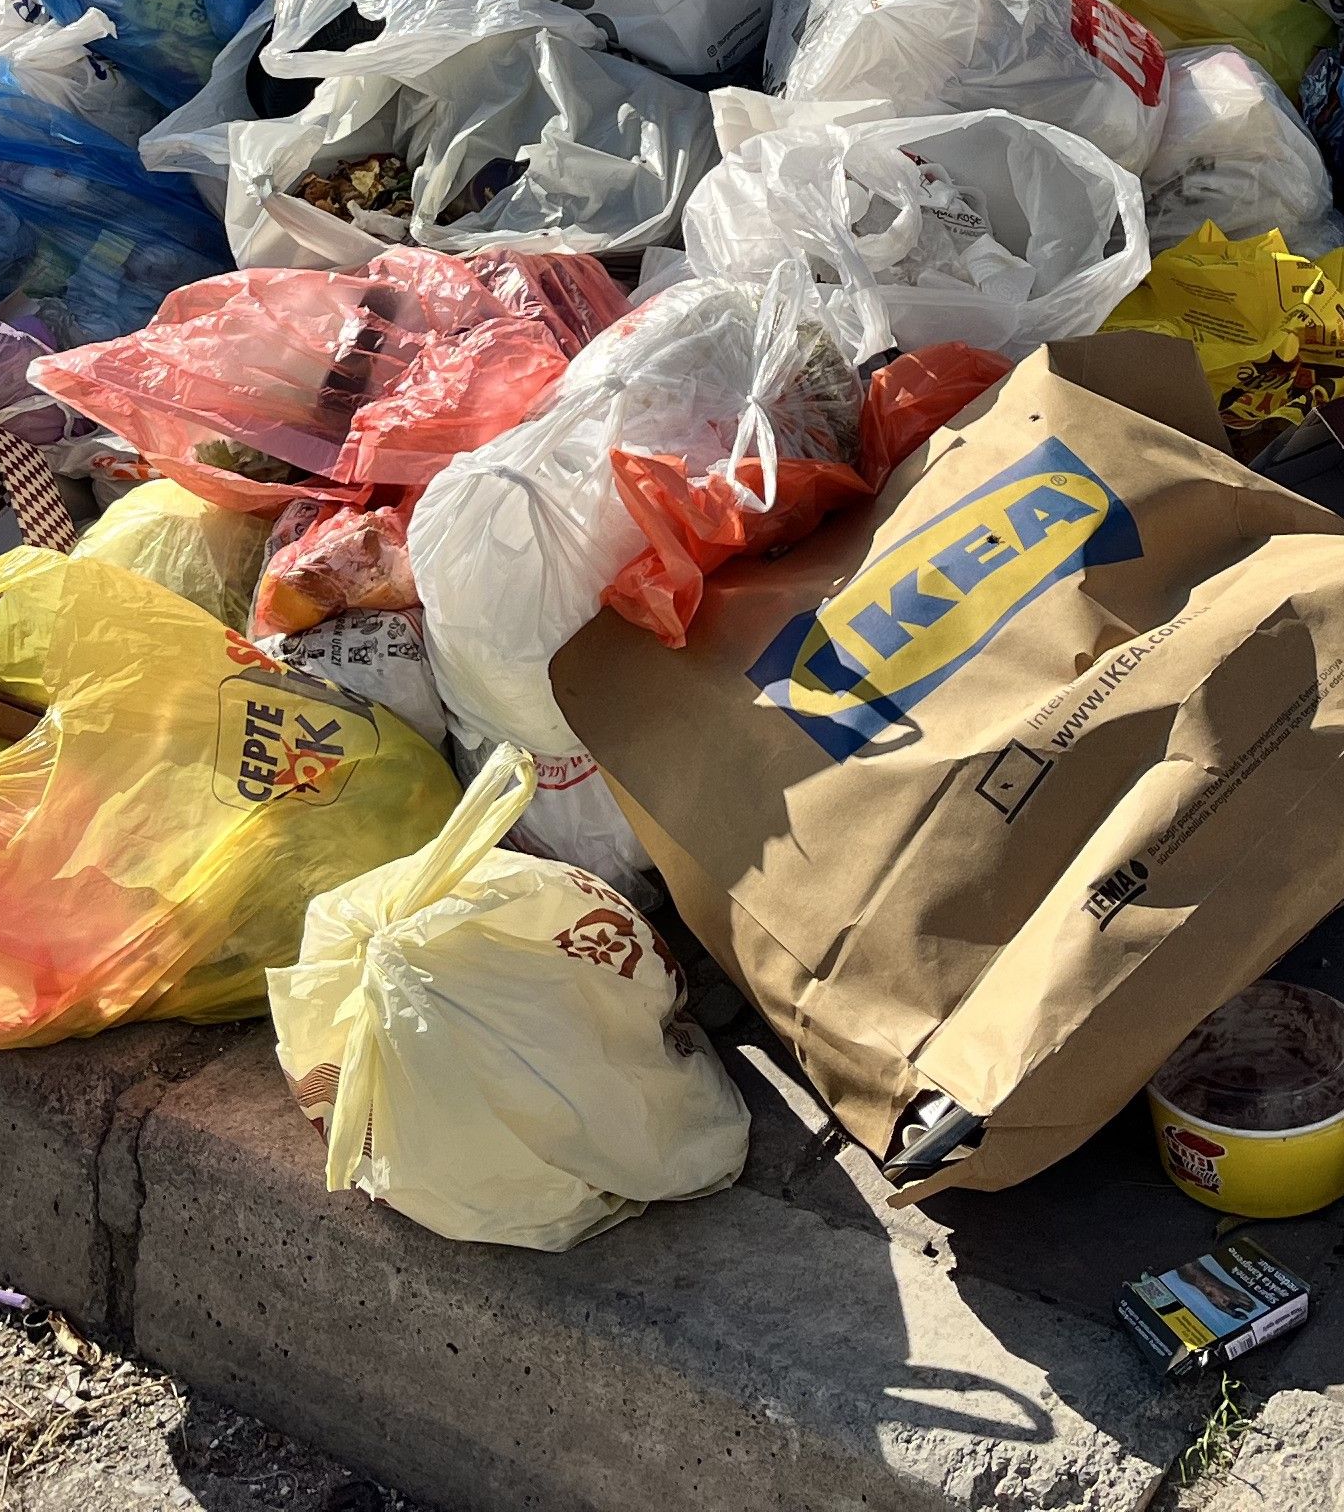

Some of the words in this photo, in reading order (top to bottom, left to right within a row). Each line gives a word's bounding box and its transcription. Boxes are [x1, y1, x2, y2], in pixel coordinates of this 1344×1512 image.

[804, 484, 1100, 697] IKEA
[237, 700, 286, 803] CEPTE
[1080, 868, 1138, 922] TEMA
